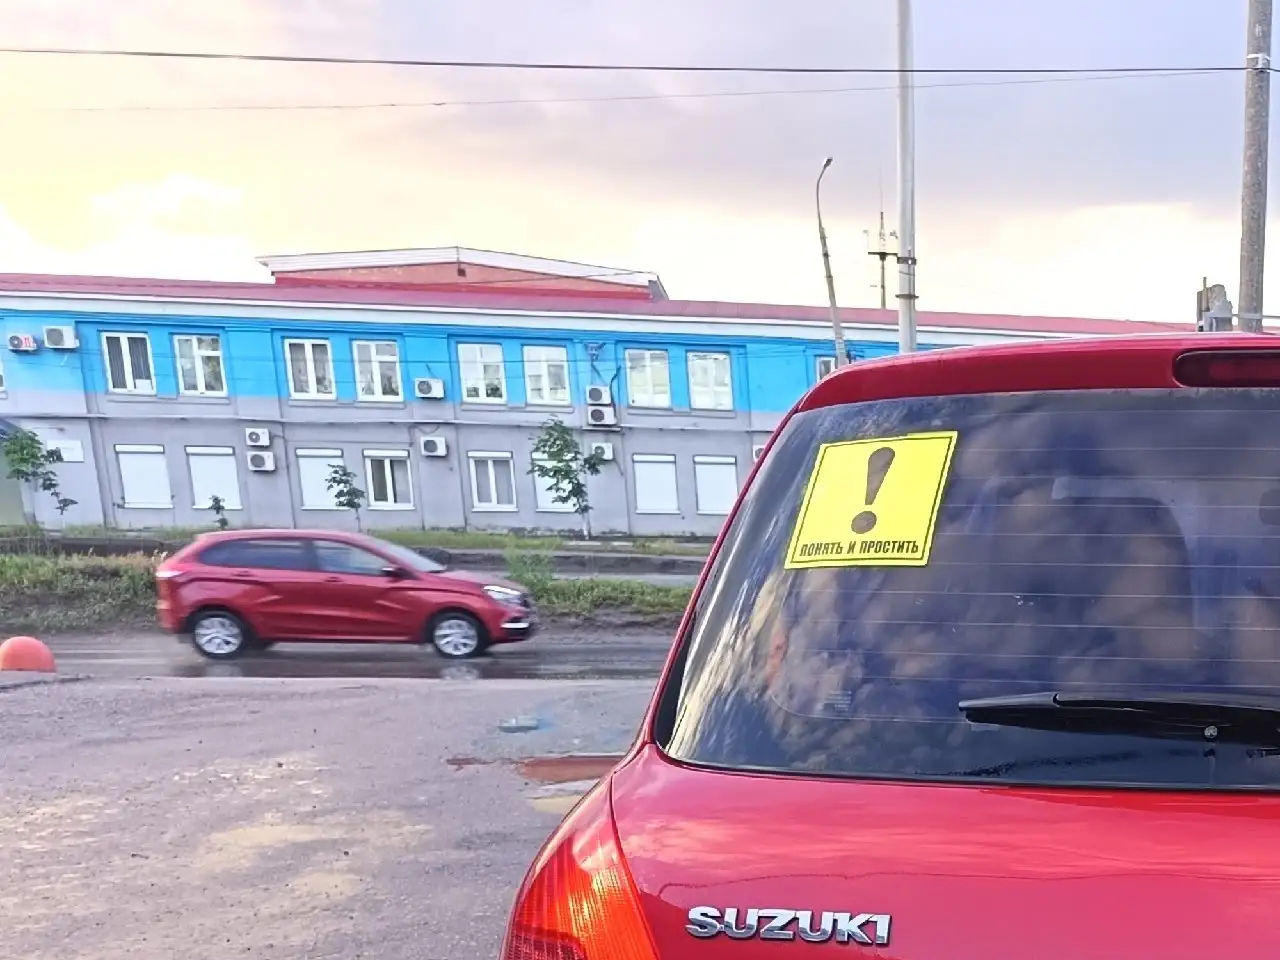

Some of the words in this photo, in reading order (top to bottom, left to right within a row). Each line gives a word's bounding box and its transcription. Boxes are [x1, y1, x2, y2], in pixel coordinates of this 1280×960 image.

[799, 541, 844, 557] ПОНЯТЬ
[847, 541, 855, 554] И
[859, 539, 920, 554] ПРОСТИТЬ
[685, 905, 892, 946] SUZUKI
